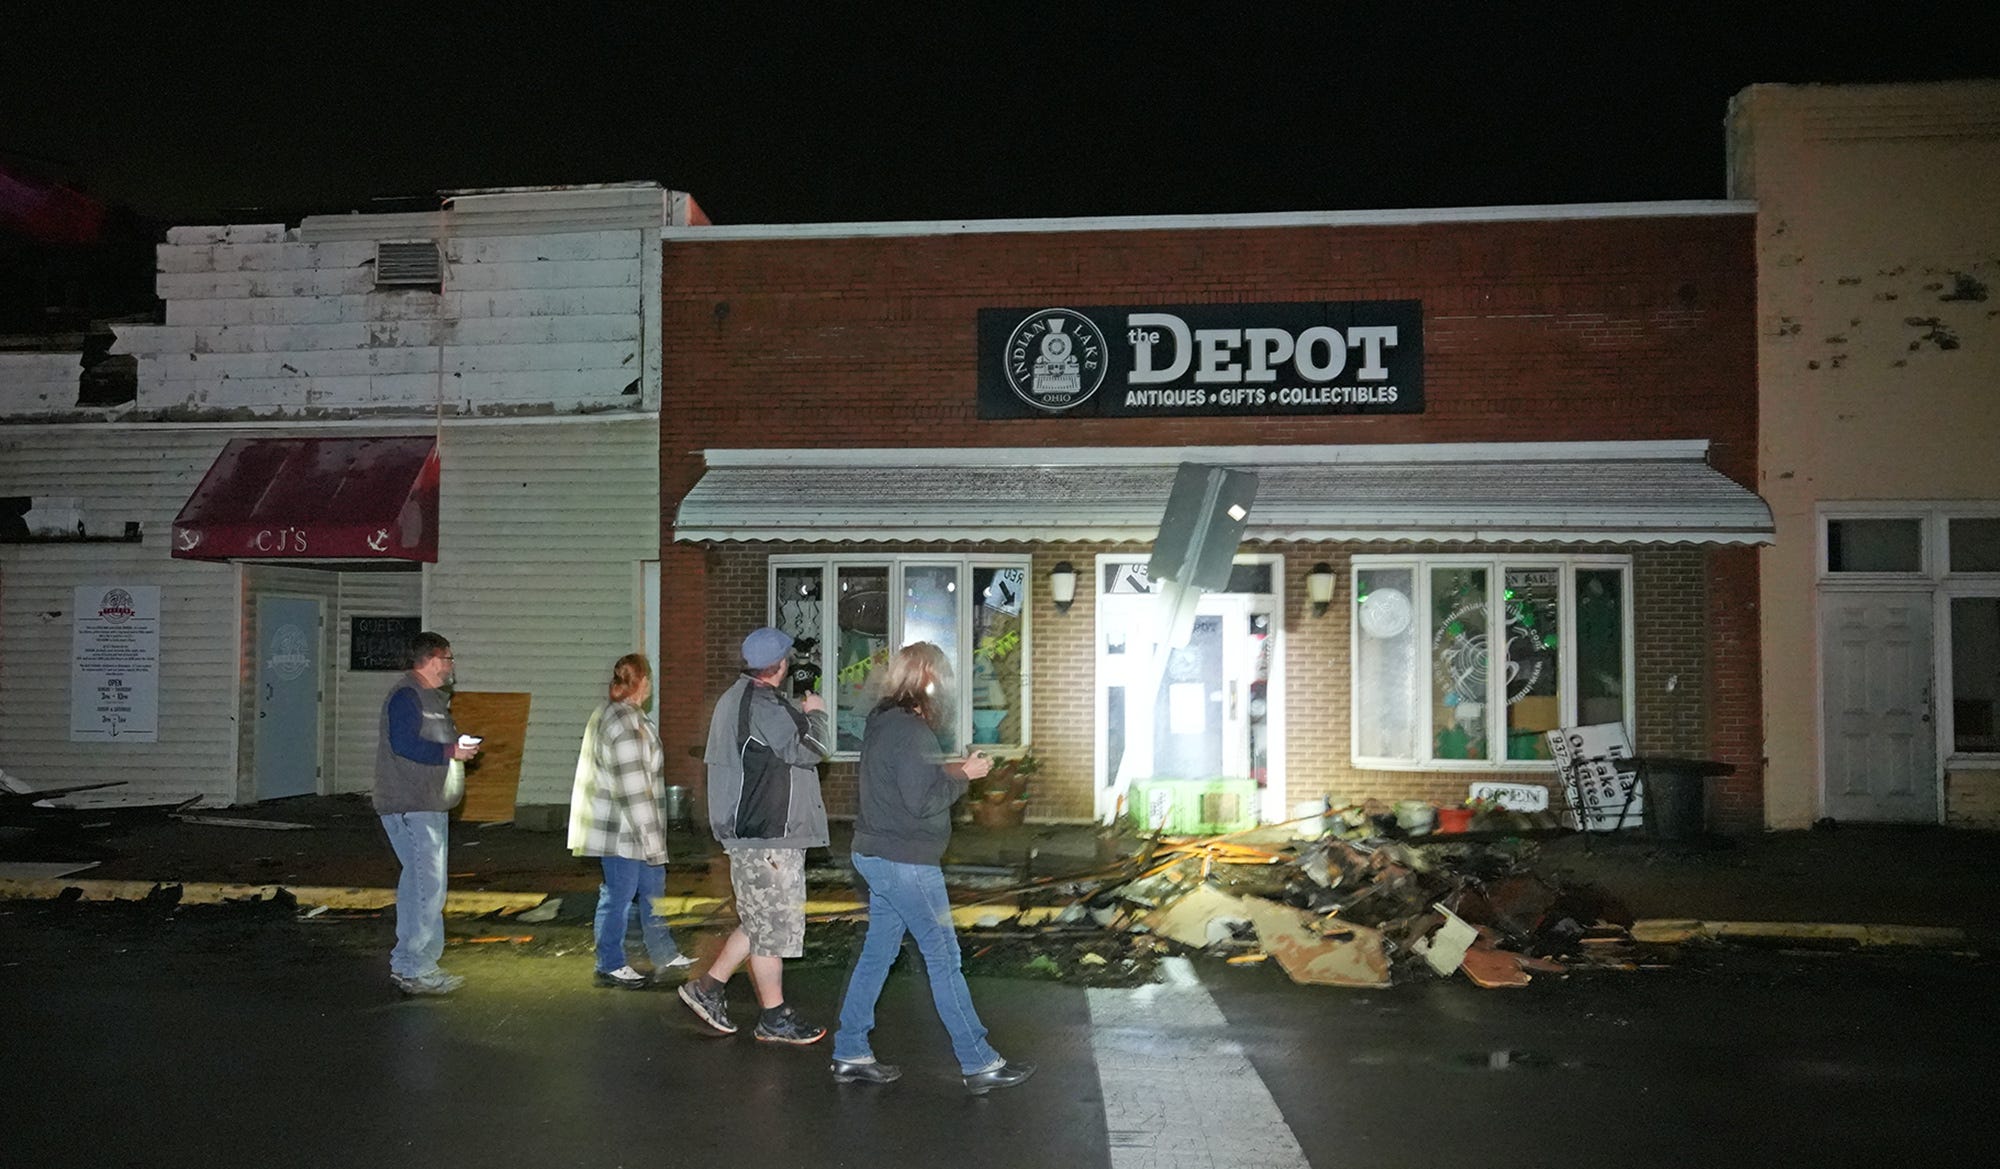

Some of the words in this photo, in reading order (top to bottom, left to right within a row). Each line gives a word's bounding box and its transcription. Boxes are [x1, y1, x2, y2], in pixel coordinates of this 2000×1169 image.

[1128, 327, 1160, 344] the
[1013, 320, 1047, 382] INDIAN
[1073, 324, 1098, 370] LAKE
[1127, 313, 1398, 385] DEPOT
[1043, 393, 1071, 402] OHIO
[1125, 387, 1206, 407] ANTIQUES
[1219, 387, 1266, 405] GIFTS
[1279, 385, 1399, 405] COLLECTIBLES
[256, 527, 308, 552] CJ'S
